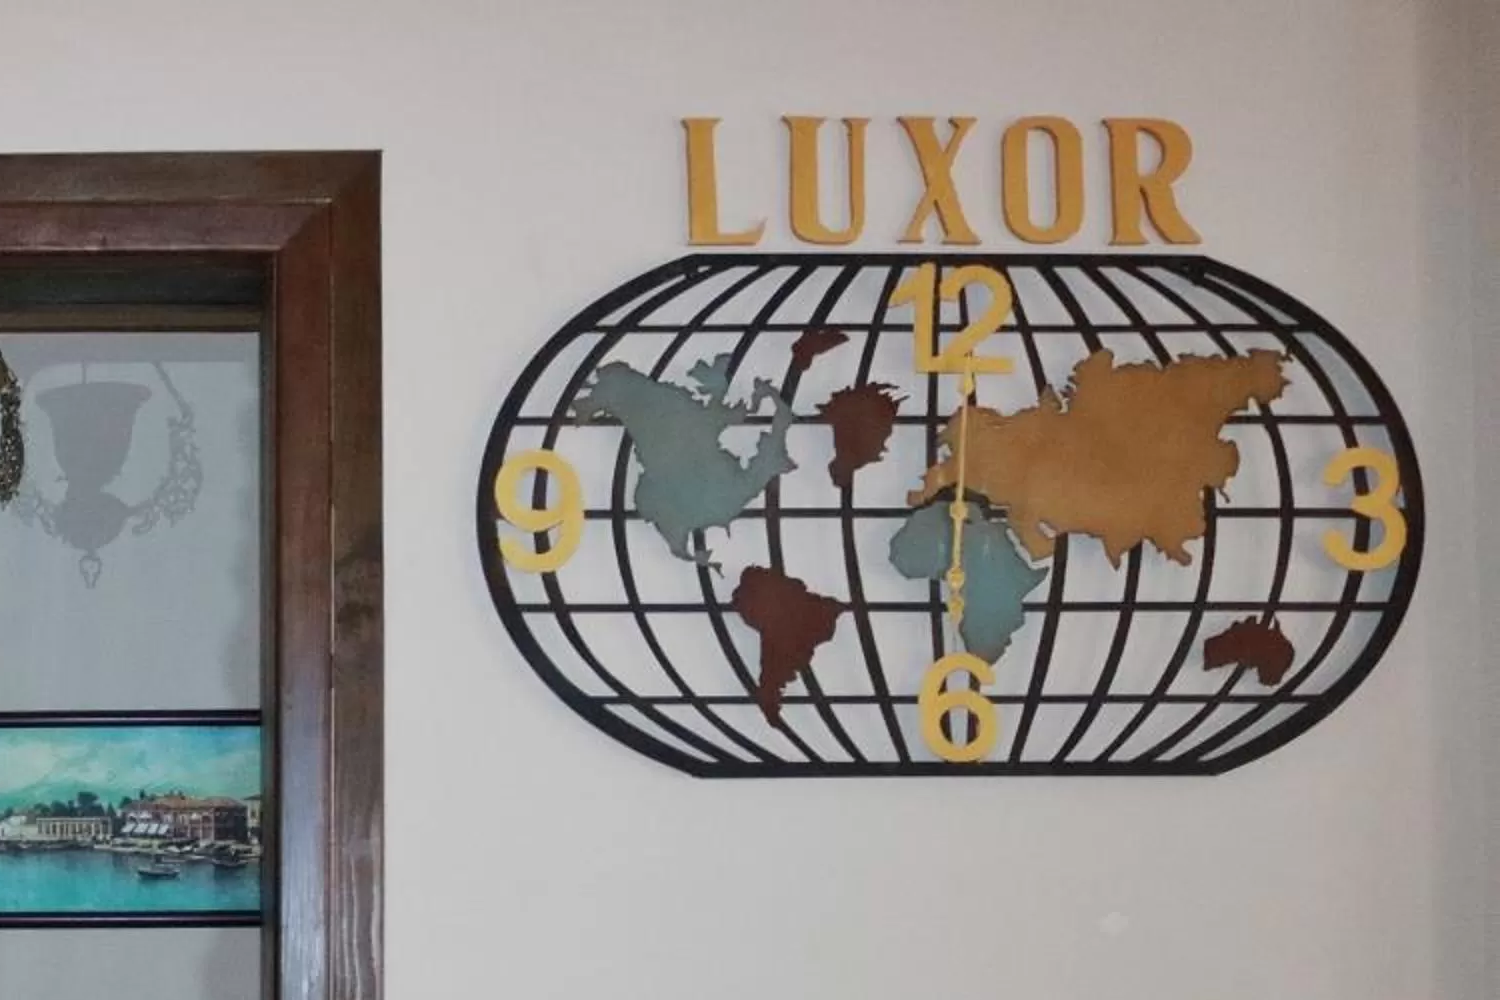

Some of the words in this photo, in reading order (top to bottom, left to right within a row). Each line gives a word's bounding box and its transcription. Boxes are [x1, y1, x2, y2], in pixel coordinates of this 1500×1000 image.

[681, 116, 1203, 245] LUXOR
[888, 262, 1016, 373] 12
[494, 449, 582, 573] 9
[1323, 447, 1407, 571] 3
[918, 653, 1000, 763] 6
